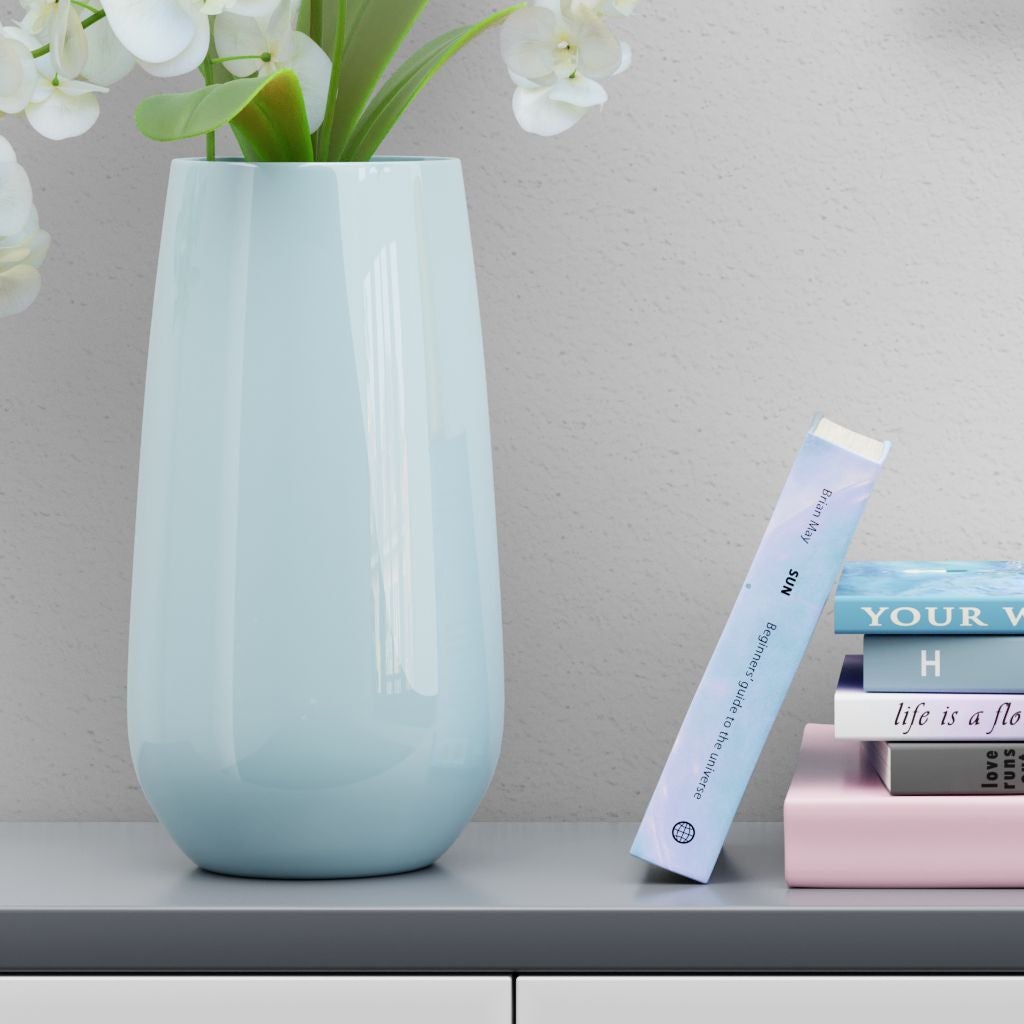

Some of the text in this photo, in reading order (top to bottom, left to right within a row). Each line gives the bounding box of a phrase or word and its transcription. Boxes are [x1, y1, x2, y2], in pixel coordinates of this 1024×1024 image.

[800, 488, 833, 544] Brian May
[780, 568, 799, 596] SUN
[860, 606, 988, 627] YOUR
[730, 680, 749, 714] guide
[723, 716, 735, 729] to
[894, 702, 930, 735] life
[941, 706, 958, 726] is
[968, 710, 984, 726] a
[714, 731, 729, 750] the
[693, 753, 719, 800] universe
[981, 750, 998, 788] love
[1003, 748, 1016, 790] runs
